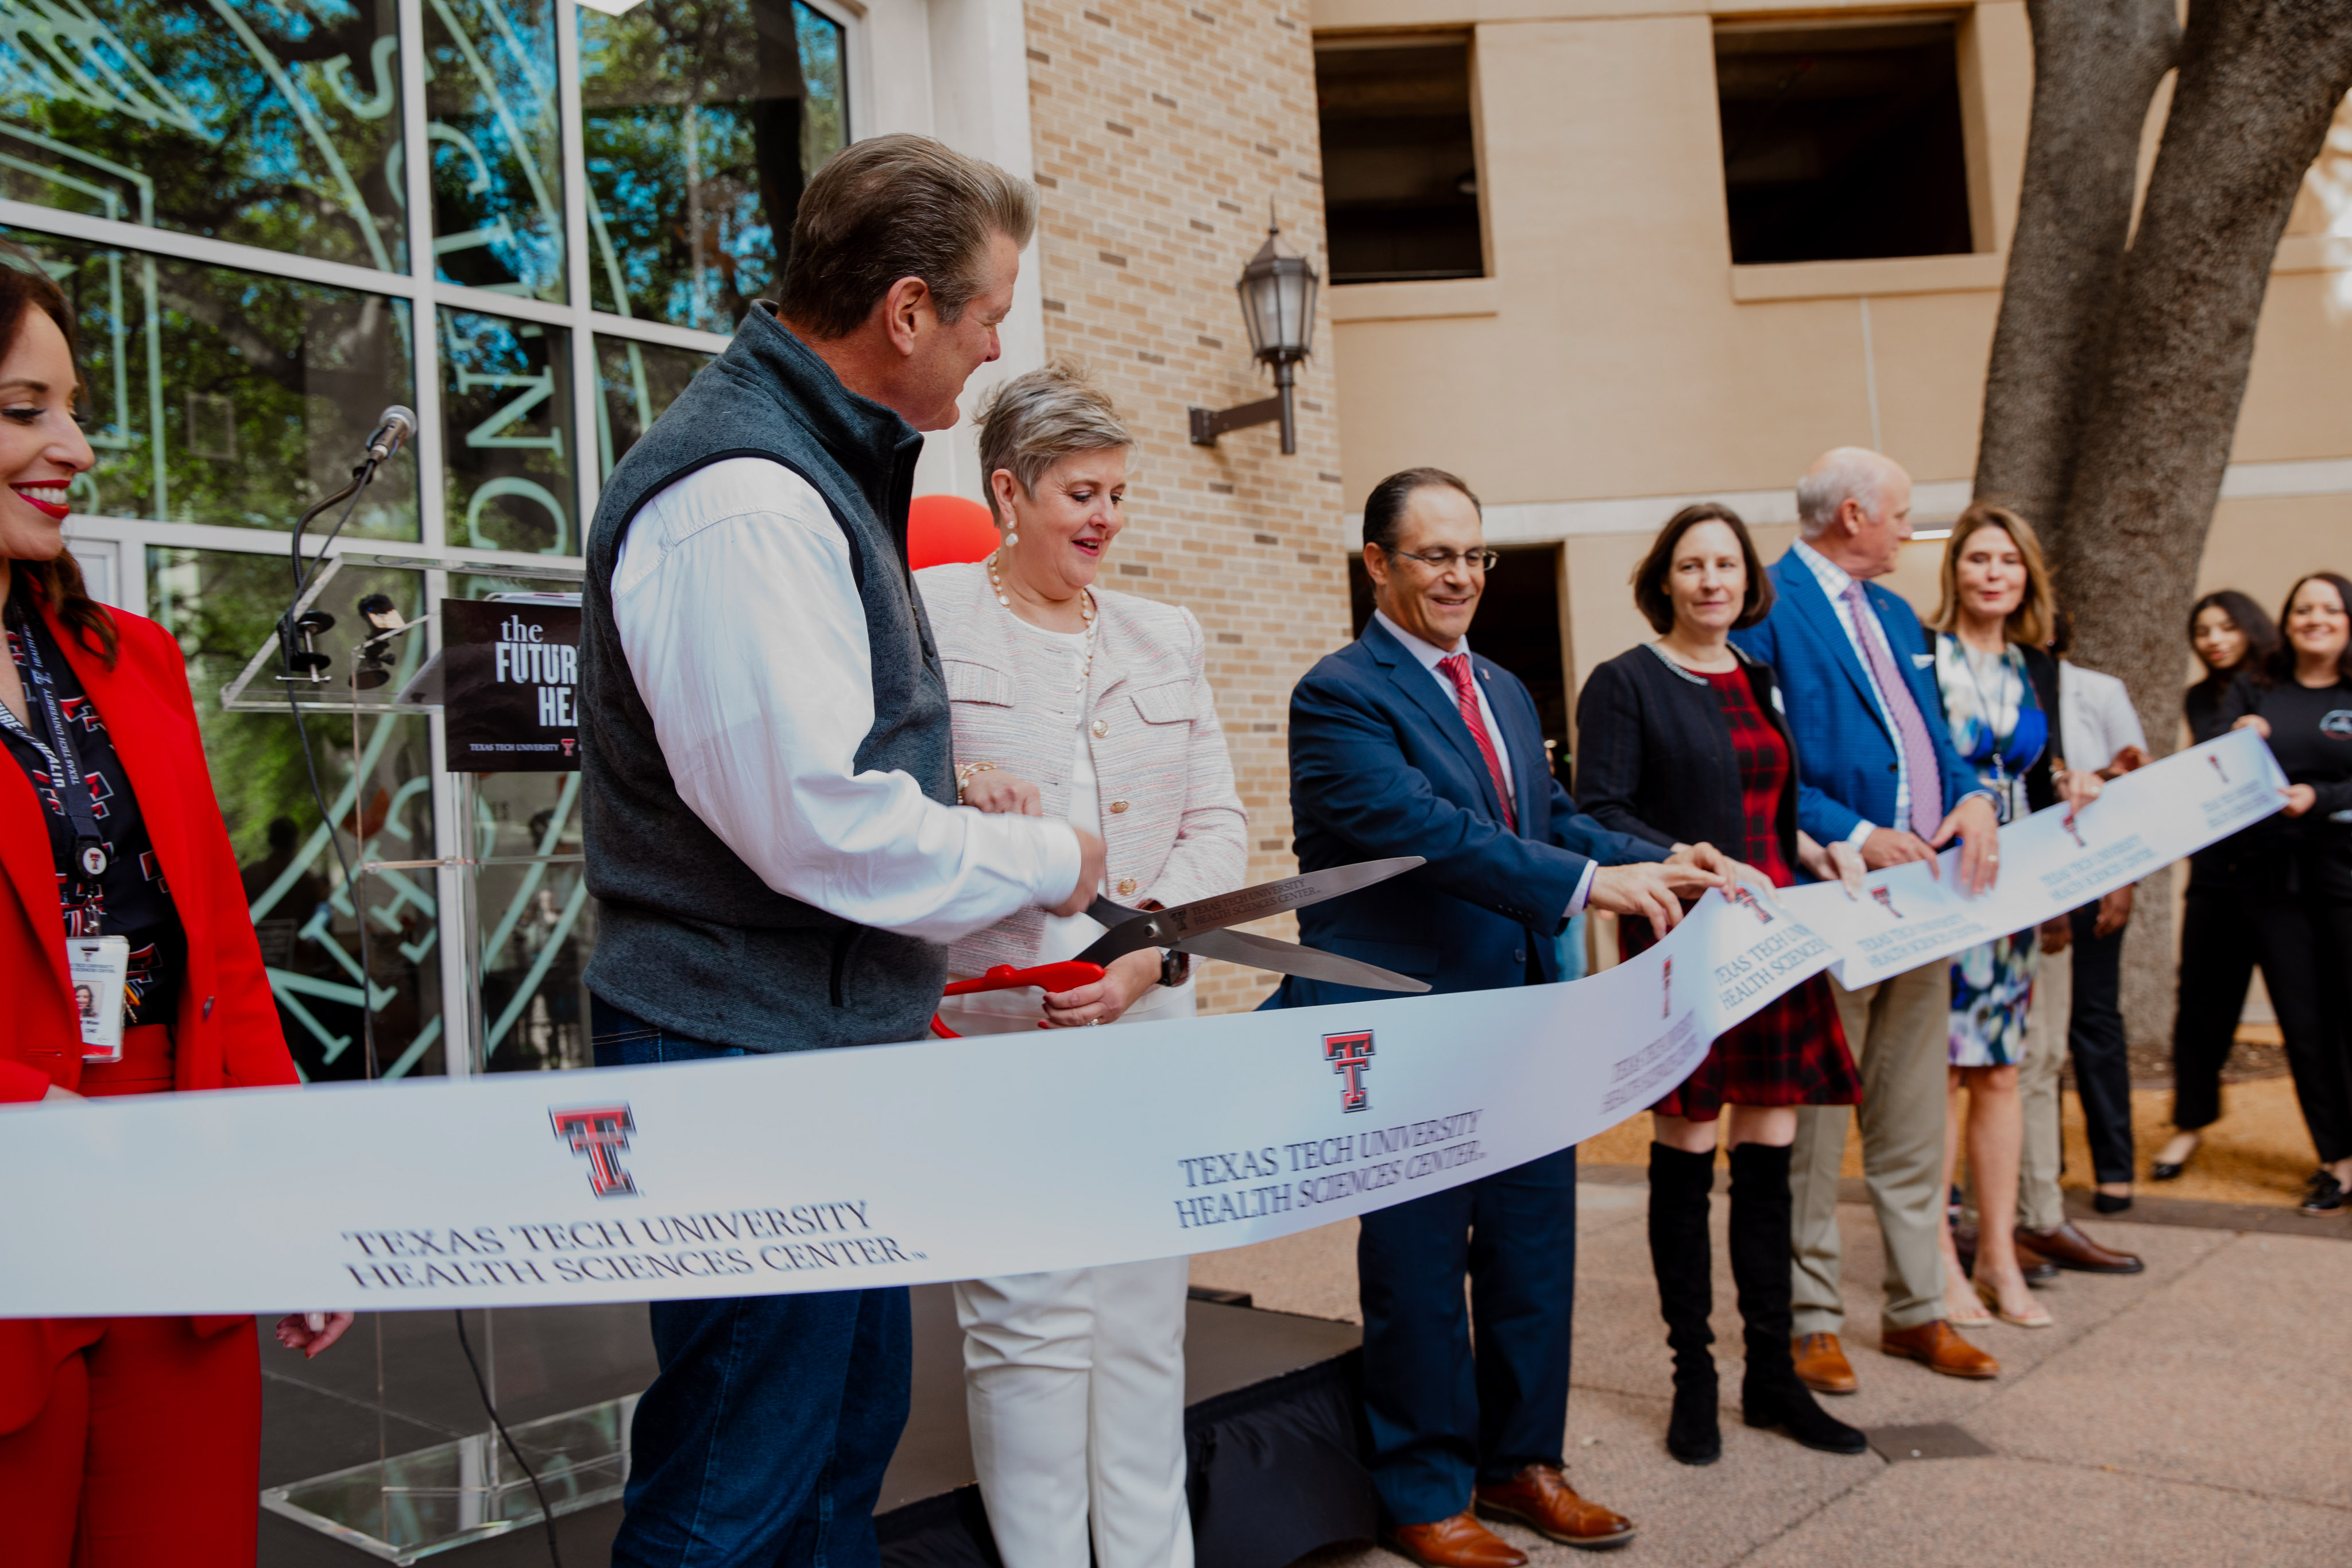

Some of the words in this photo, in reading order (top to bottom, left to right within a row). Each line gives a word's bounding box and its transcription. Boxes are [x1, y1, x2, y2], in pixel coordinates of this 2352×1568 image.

[500, 614, 544, 643] the
[495, 642, 580, 684] FUTUR
[41, 688, 65, 735] UNIVERSITY
[57, 737, 72, 758] TECH
[469, 744, 494, 752] TEXAS
[494, 744, 515, 752] TECH
[516, 744, 559, 752] UNIVERSITY
[64, 759, 80, 785] TEXAS
[1192, 901, 1221, 916] TEXAS
[1222, 894, 1248, 908] TECH
[1250, 878, 1305, 901] UNIVERSITY
[1194, 909, 1231, 925] HEALTH
[1233, 897, 1276, 915] SCIENCES
[1178, 1147, 1279, 1188] TEXAS
[1283, 1135, 1355, 1171] TECH
[1359, 1109, 1484, 1158] UNIVERSITY
[1173, 1183, 1293, 1229] HEALTH
[1297, 1160, 1403, 1208] SCIENCES
[340, 1226, 506, 1257] TEXAS
[508, 1220, 636, 1252] TECH
[636, 1199, 872, 1245] UNIVERSITY
[342, 1260, 550, 1290] HEALTH
[551, 1248, 755, 1283] SCIENCES
[759, 1237, 910, 1272] CENTER
